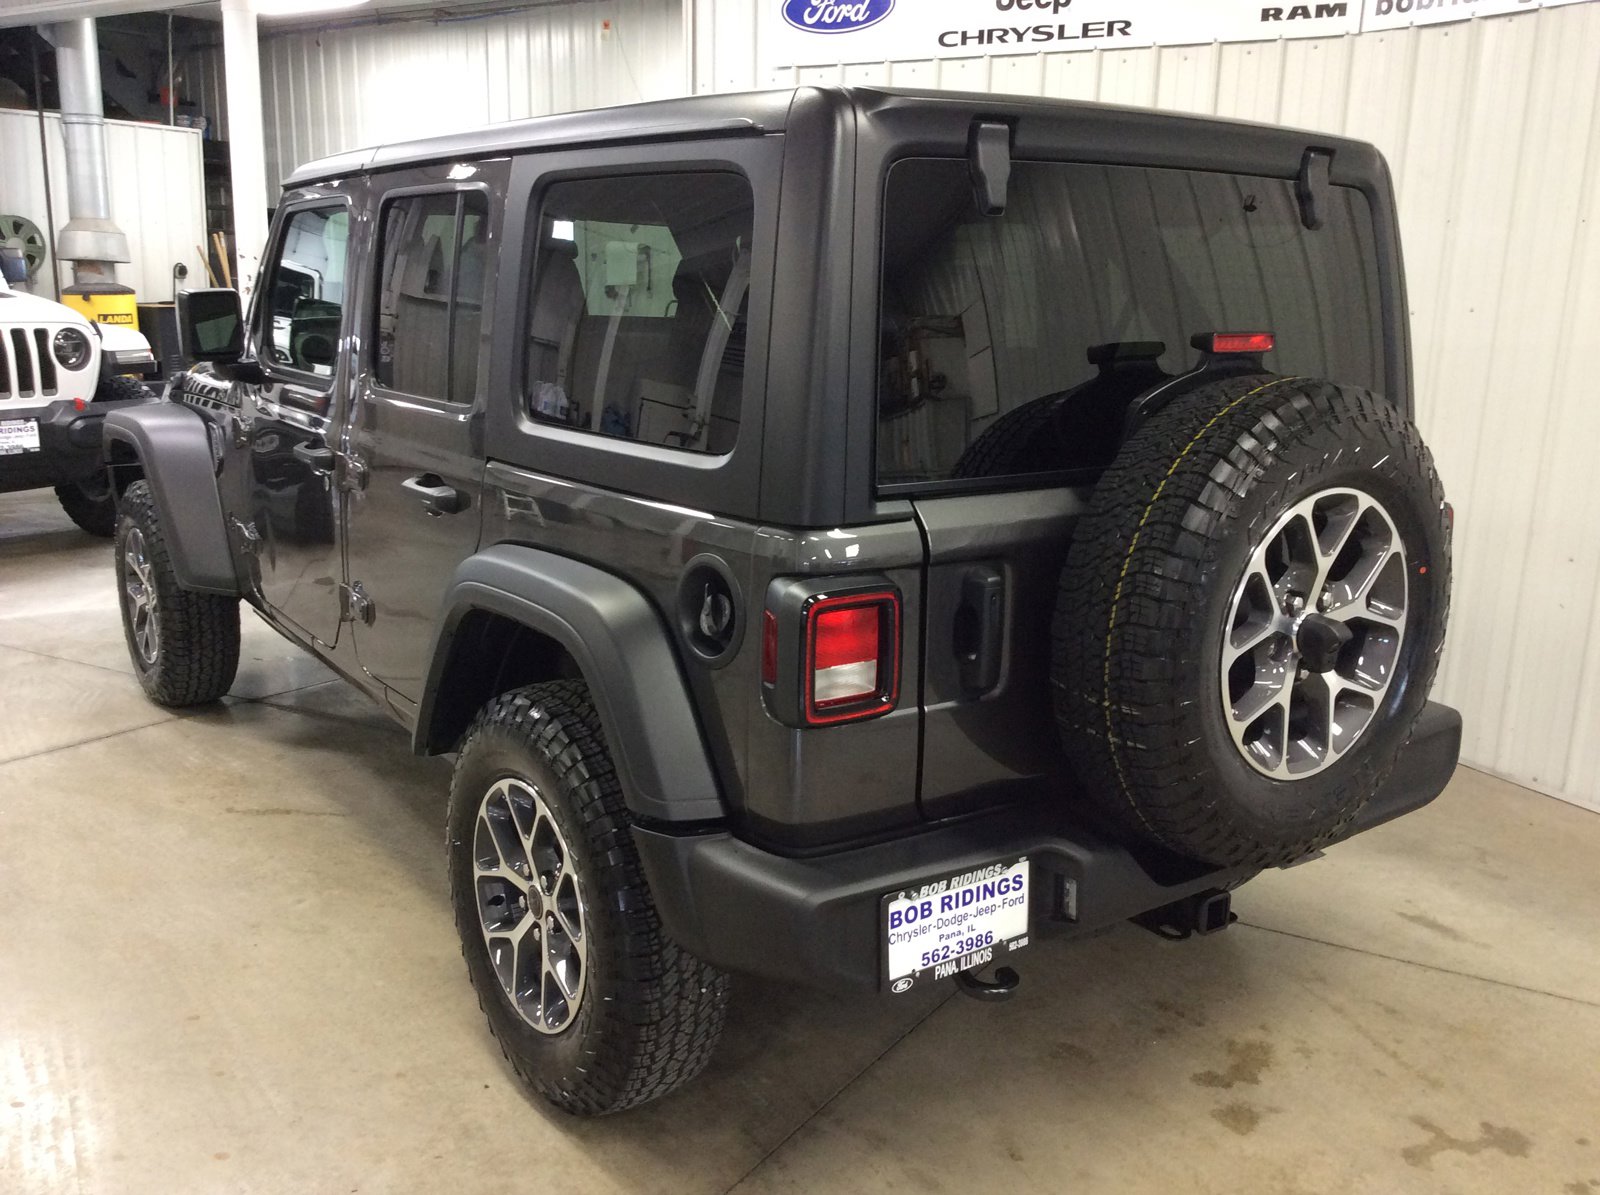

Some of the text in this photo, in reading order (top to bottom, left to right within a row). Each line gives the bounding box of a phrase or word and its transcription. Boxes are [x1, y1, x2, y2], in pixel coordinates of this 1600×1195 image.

[1260, 2, 1347, 22] RAM
[938, 19, 1132, 48] CHRYSLER
[920, 863, 1002, 898] BOB RIDINGS
[890, 873, 1024, 930] BOB RIDINGS
[967, 924, 976, 933] IL
[921, 930, 994, 967] 562-3986
[960, 948, 992, 971] ILLINOIS
